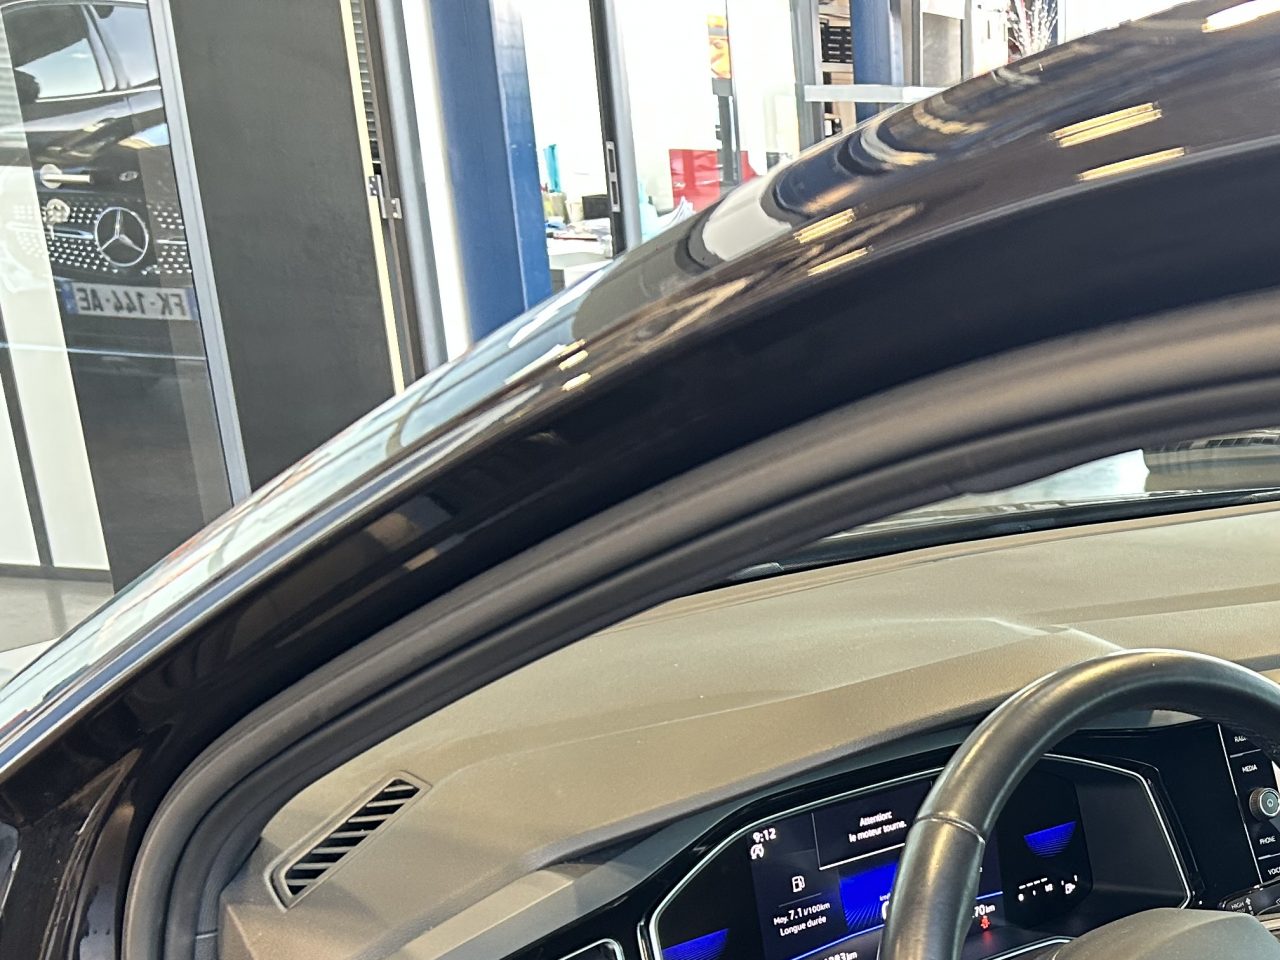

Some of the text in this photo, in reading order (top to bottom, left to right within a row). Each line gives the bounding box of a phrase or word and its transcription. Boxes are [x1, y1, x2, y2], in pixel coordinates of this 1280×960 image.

[1242, 764, 1258, 773] MEDIA
[752, 827, 777, 843] 9:12
[848, 833, 857, 843] le
[857, 827, 882, 841] moteur
[1259, 835, 1276, 845] PHONE
[1231, 901, 1245, 910] HIGH
[788, 907, 803, 921] 7.1
[780, 915, 827, 936] Longue durée
